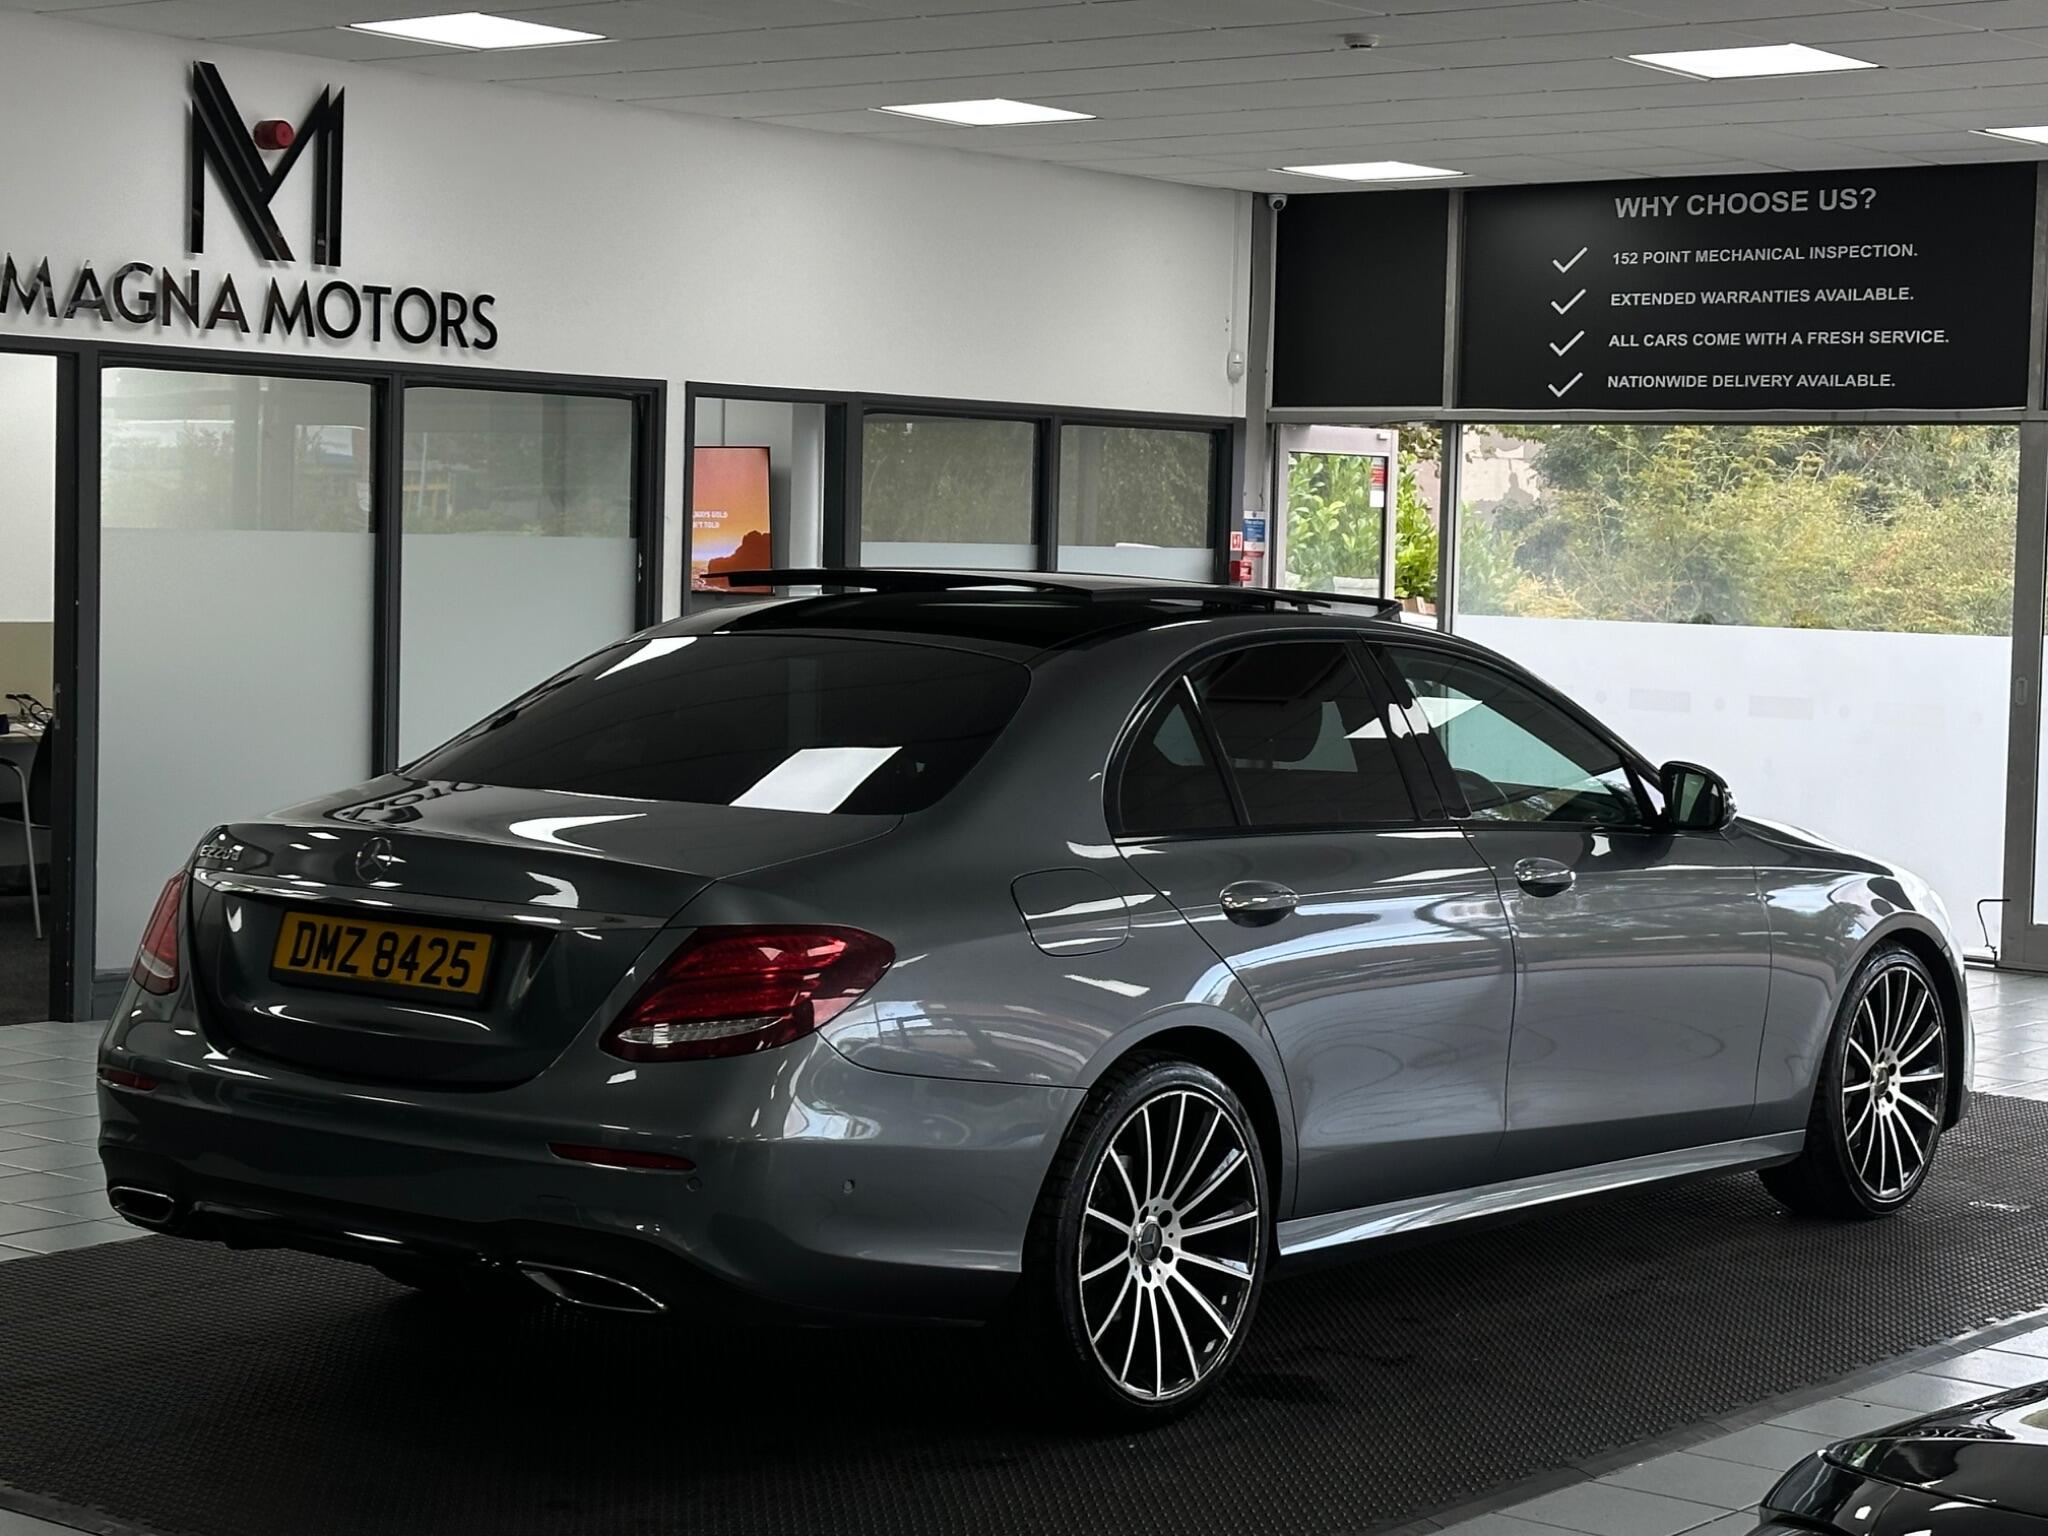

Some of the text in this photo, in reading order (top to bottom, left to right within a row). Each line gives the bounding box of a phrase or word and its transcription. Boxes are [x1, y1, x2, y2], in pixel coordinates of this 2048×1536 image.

[1614, 187, 1877, 218] WHY CHOOSE US?
[1612, 243, 1918, 265] 152 POINT MECHANICAL INSPECTION.
[0, 252, 498, 350] MAGNA MOTORS
[1610, 286, 1914, 307] EXTENDED WARRANTIES AVAILABLE.
[1608, 329, 1950, 348] ALL CARS COME WITH A FRESH SERVICE.
[1607, 373, 1896, 389] NATIONWIDE DELIVERY AVAILABLE.
[289, 921, 476, 988] DMZ 8425
